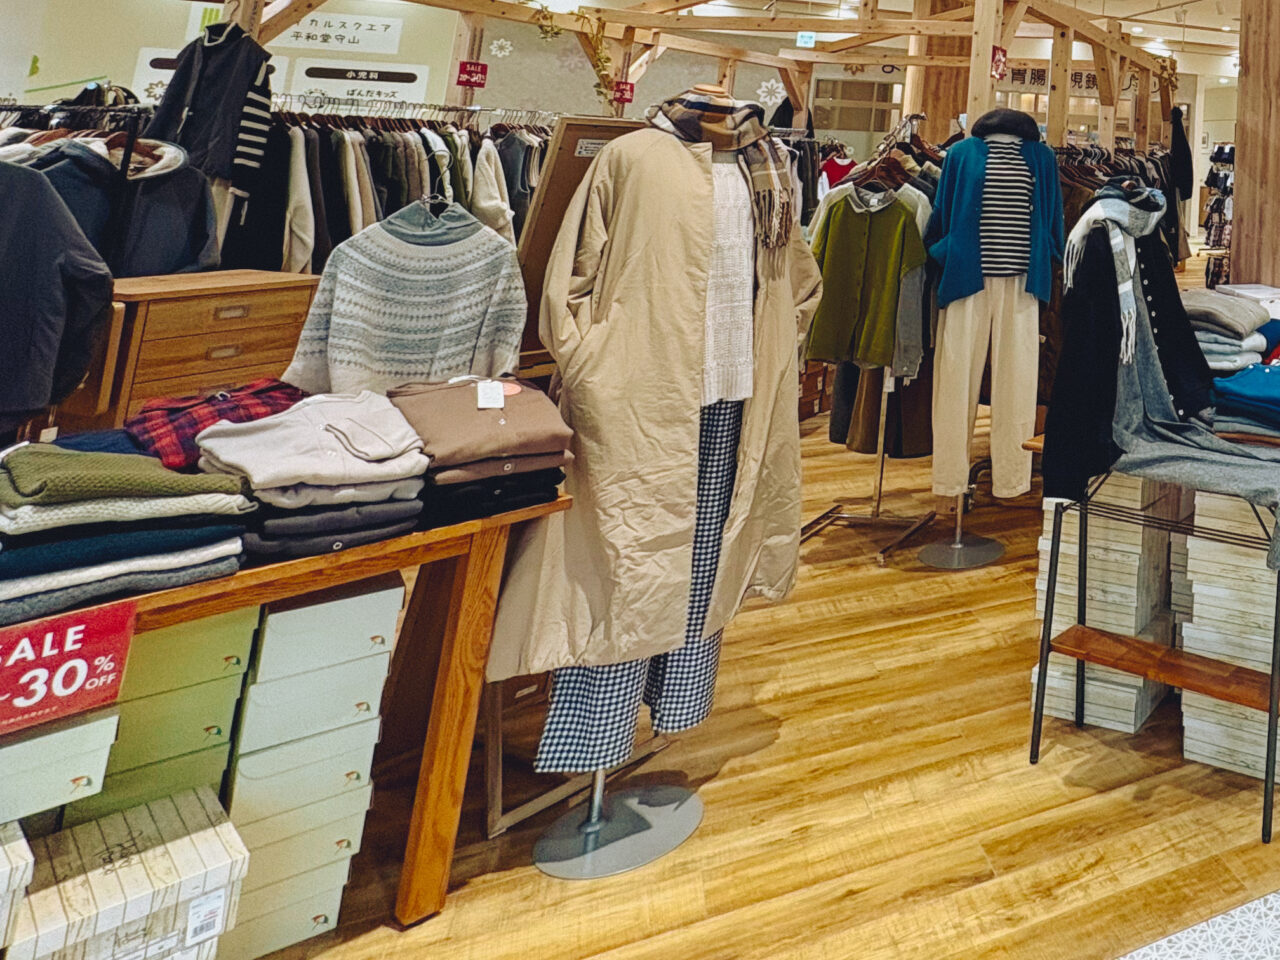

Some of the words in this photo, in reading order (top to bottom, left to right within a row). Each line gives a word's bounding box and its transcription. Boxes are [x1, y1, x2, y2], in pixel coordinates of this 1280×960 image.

[291, 31, 360, 44] 平和堂守山
[346, 71, 379, 80] 小児科
[0, 624, 87, 667] ALE
[84, 672, 118, 691] OFF
